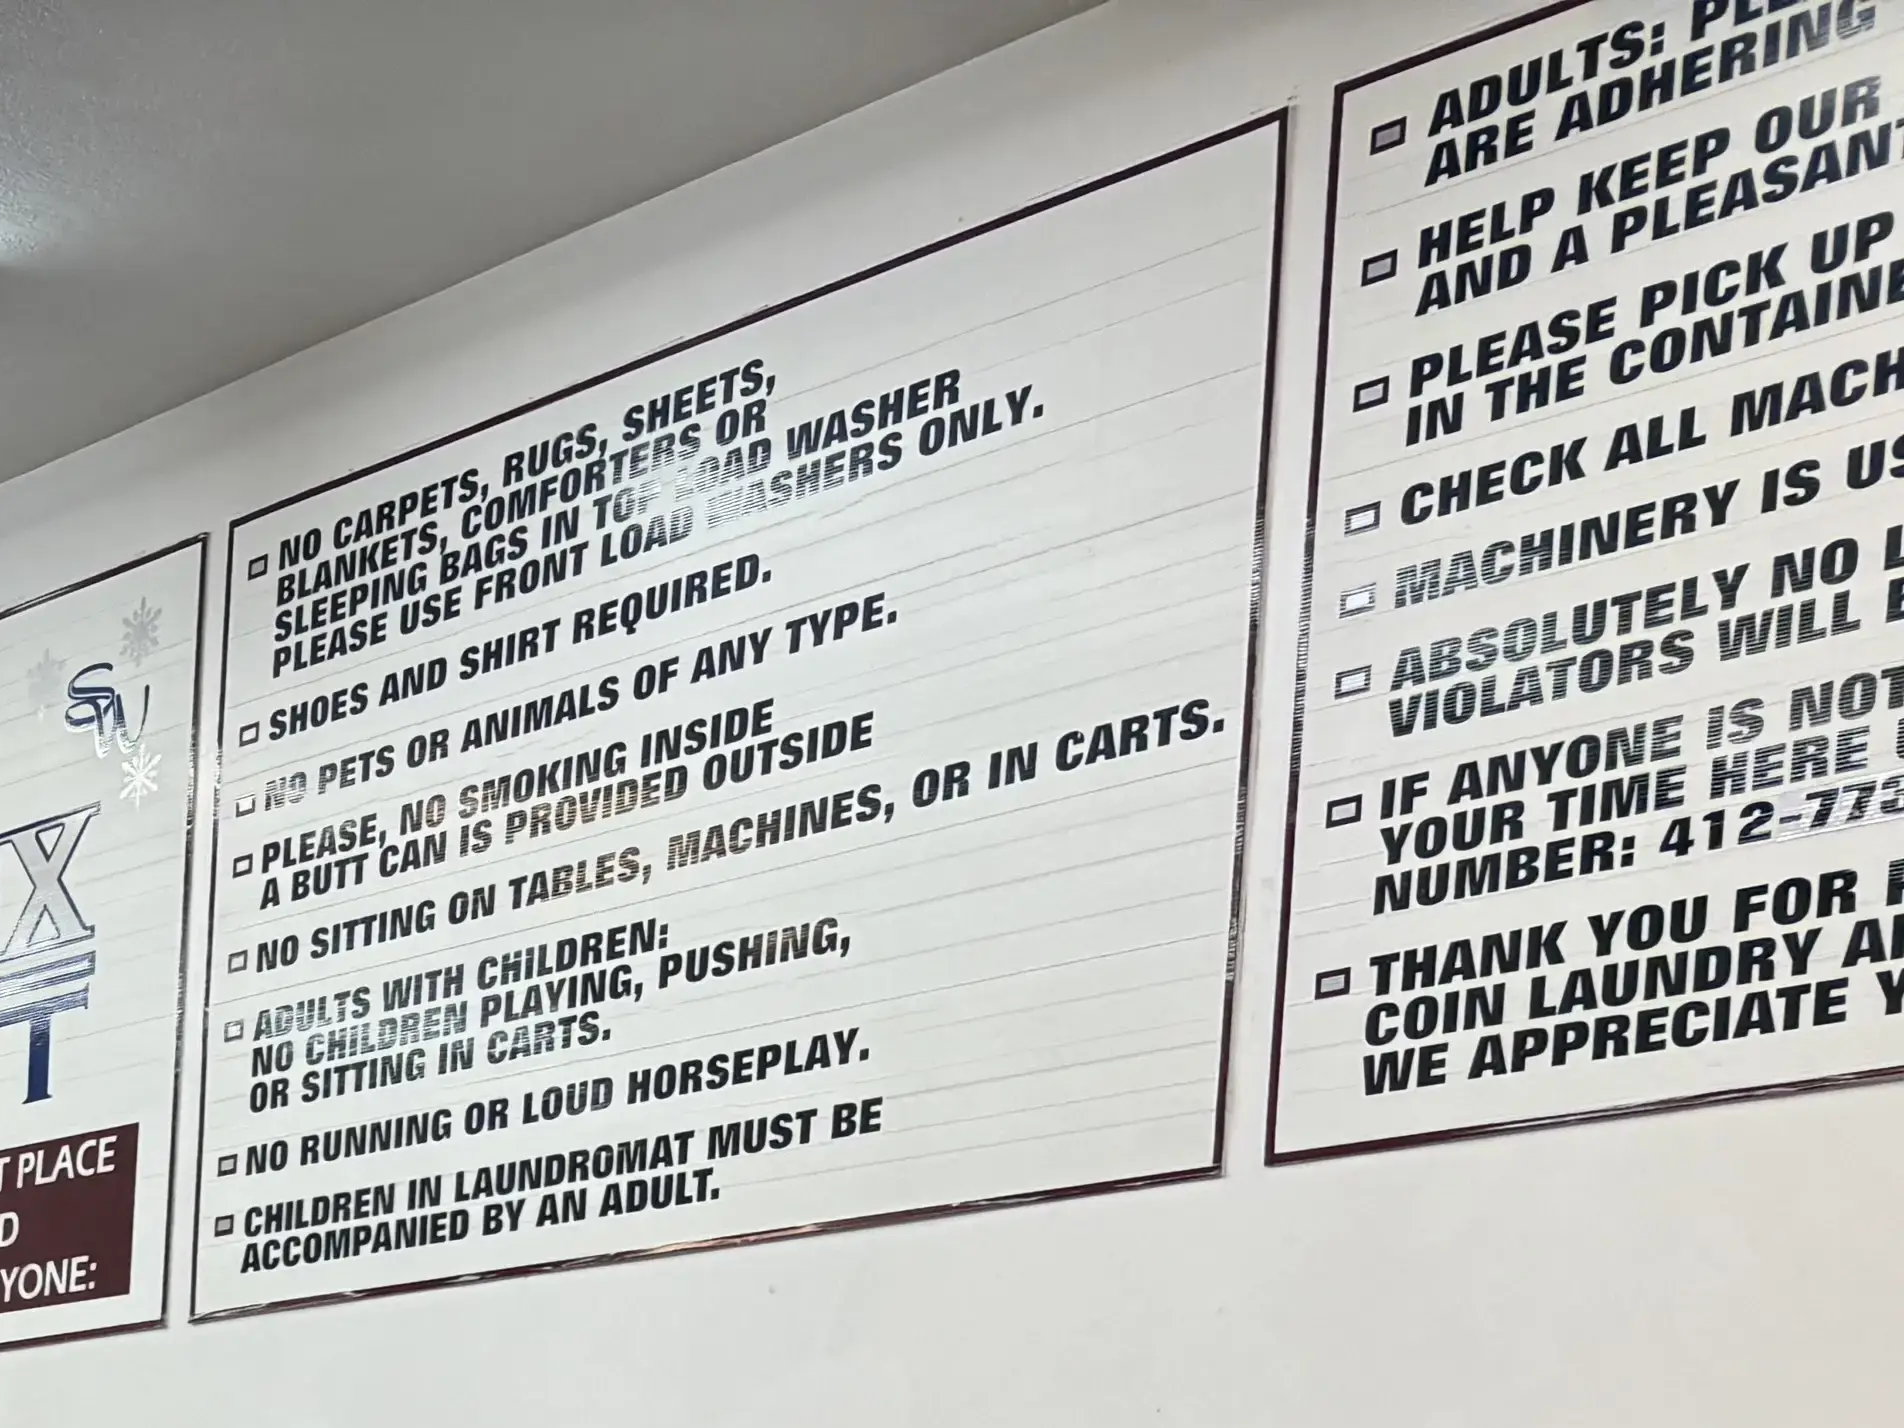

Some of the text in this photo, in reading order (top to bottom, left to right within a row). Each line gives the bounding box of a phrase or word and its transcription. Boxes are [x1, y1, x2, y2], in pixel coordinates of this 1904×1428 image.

[1425, 0, 1875, 186] ARE ADHERING
[1428, 20, 1665, 135] ADULTS:
[1418, 76, 1880, 268] HELP KEEP OUR
[1409, 211, 1894, 398] PLEASE PICK UP
[1415, 244, 1532, 317] AND
[278, 358, 776, 571] NO CARPETS, RUGS, SHEETS,
[1400, 436, 1588, 525] CHECK
[1604, 406, 1706, 472] ALL
[1405, 354, 1587, 447] IN THE
[272, 384, 1043, 679] PLEASE USE FRONT ONLY.
[274, 369, 960, 642] SLEEPING BAGS WASHER
[276, 422, 701, 608] BLANKETS, COMFORTERS
[1394, 459, 1820, 609] MACHINERY IS
[269, 553, 772, 741] SHOES AND SHIRT REQUIRED.
[1388, 629, 1694, 737] VIOLATORS
[1717, 589, 1861, 661] WILL
[1390, 538, 1858, 692] ABSOLUTELY NO
[318, 592, 897, 795] PETS OR ANIMALS ANY TYPE.
[1380, 665, 1904, 820] IF ANYONE IS NOT
[256, 699, 1224, 973] NO SITTING TABLES, MACHINES, OR CARTS.
[261, 698, 774, 874] PLEASE, NO SMOKING INSIDE
[291, 711, 874, 902] BUTT CAN OUTSIDE
[1380, 800, 1525, 865] YOUR
[1547, 764, 1687, 832] TIME
[1709, 725, 1870, 800] HERE
[1369, 920, 1568, 997] THANK
[1587, 894, 1708, 957] YOU
[1733, 869, 1858, 933] FOR
[1373, 830, 1636, 916] NUMBER:
[251, 917, 850, 1078] NO PLAYING, PUSHING,
[383, 917, 669, 1012] WITH CHILDREN:
[1363, 976, 1849, 1096] WE APPRECIATE
[1365, 927, 1823, 1046] COIN LAUNDRY
[245, 1027, 869, 1176] NO RUNNING OR LOUD HORSEPLAY.
[301, 1048, 426, 1103] SITTING
[17, 1136, 117, 1188] PLACE
[240, 1167, 720, 1274] ACCOMPANIED ADULT.
[244, 1096, 883, 1237] CHILDREN LAUNDROMAT MUST BE
